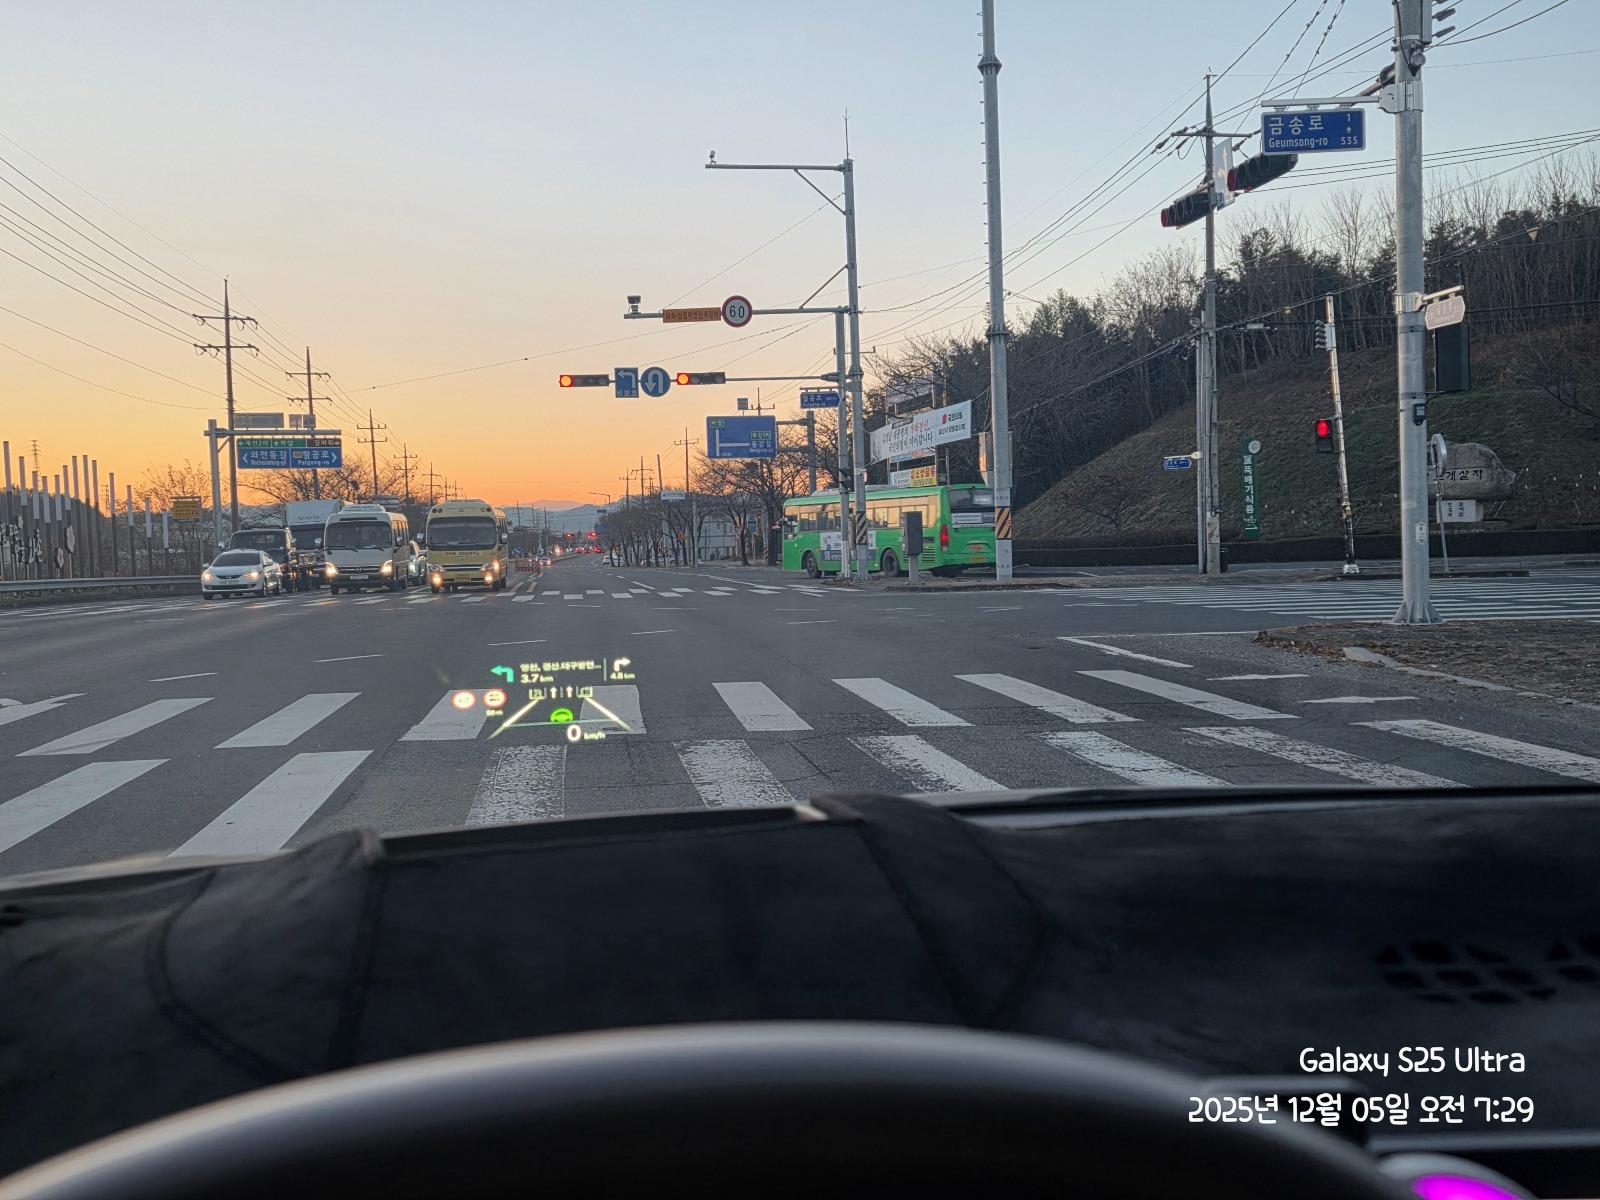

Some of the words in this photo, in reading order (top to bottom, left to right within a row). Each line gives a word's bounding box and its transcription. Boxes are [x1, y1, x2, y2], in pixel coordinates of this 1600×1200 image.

[1346, 114, 1351, 122] 1
[1268, 115, 1324, 135] 금송로
[1268, 137, 1328, 148] Geumsong-ro
[1341, 136, 1358, 145] 535
[729, 305, 745, 319] 60
[303, 450, 330, 460] 팔공로
[566, 724, 582, 742] 0
[583, 731, 606, 741] km/h
